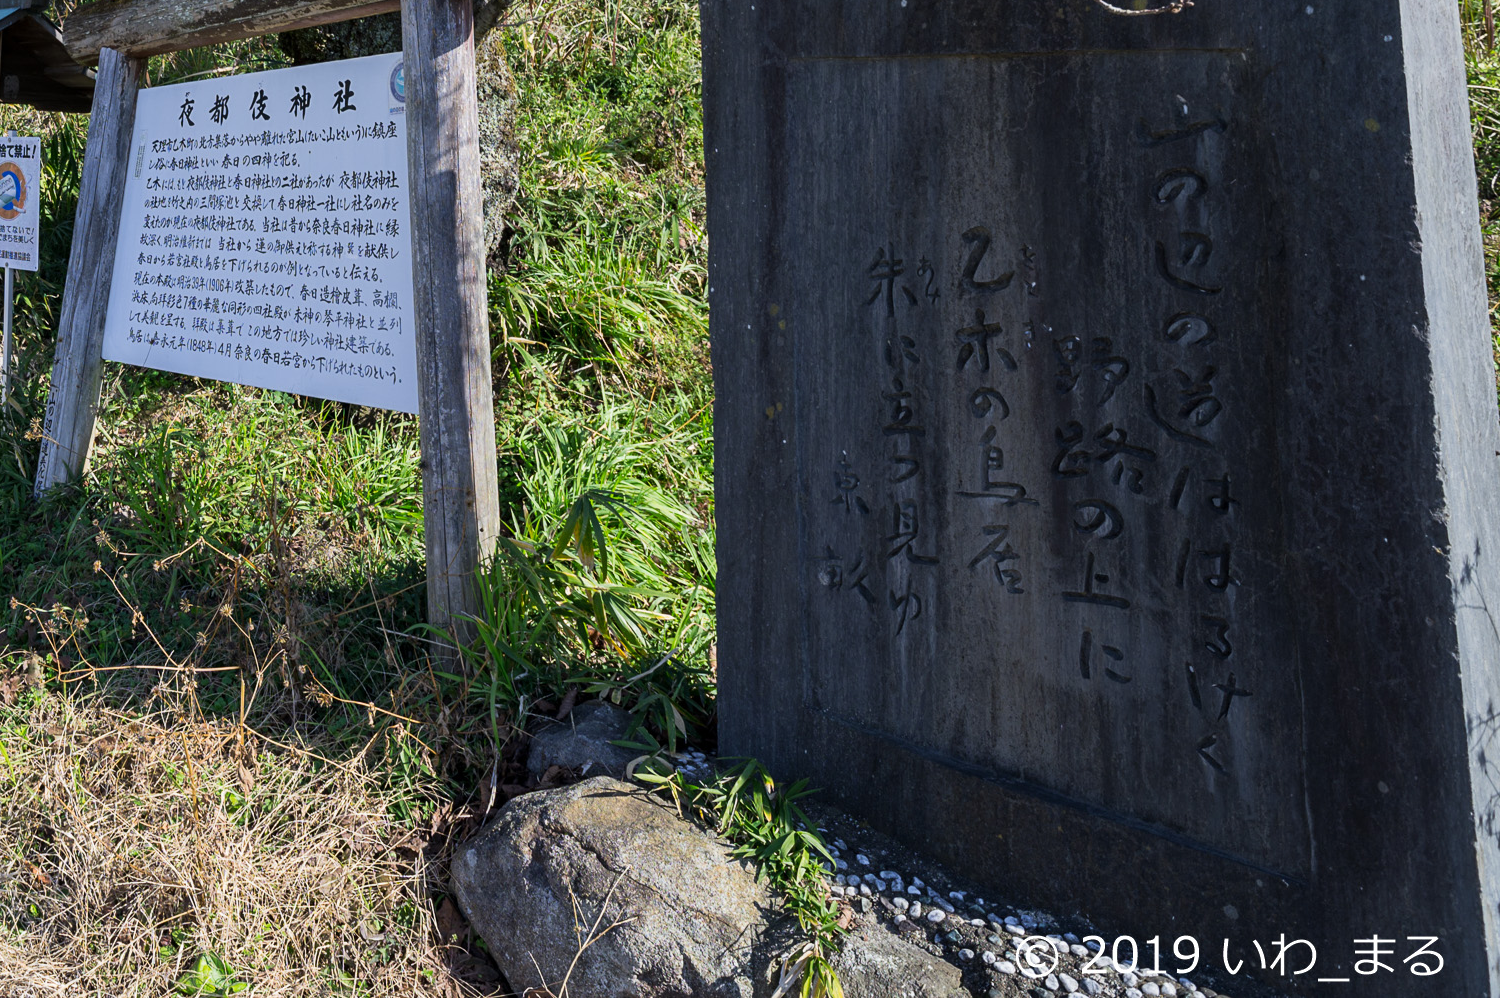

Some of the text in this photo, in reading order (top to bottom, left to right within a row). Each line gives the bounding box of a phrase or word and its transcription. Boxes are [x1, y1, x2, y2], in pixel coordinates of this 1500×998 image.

[179, 80, 357, 127] 夜都伎神社
[955, 226, 1039, 595] 乙木の鳥居
[1051, 332, 1156, 686] 野路の上に
